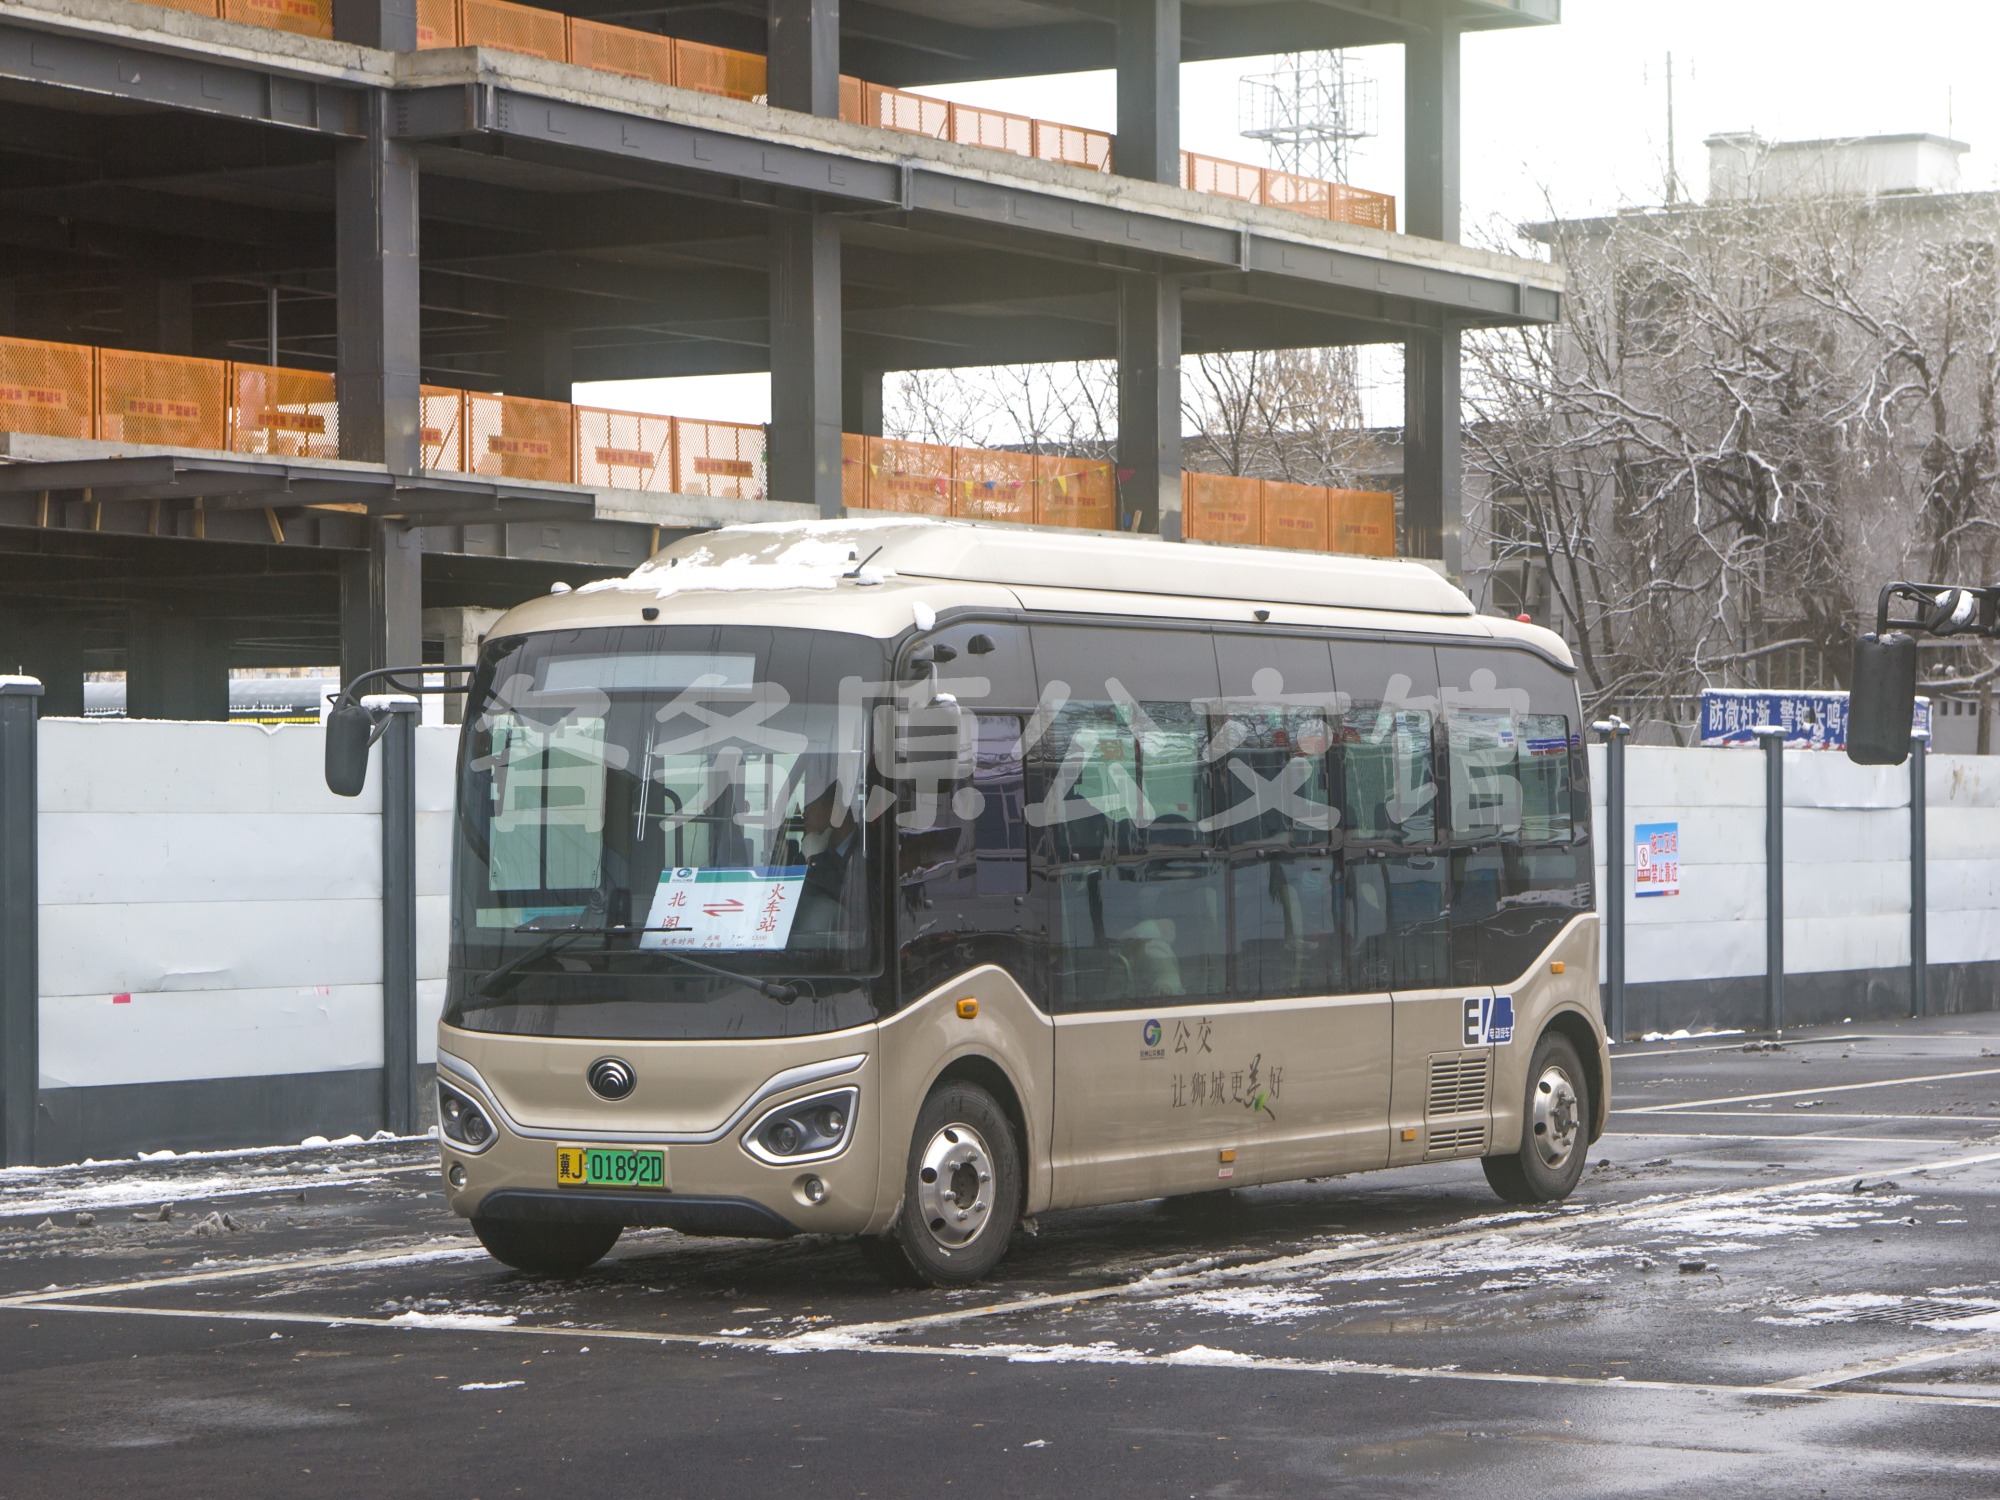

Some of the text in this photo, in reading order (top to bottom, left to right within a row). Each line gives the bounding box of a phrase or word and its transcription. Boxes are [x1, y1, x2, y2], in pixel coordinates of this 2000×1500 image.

[1709, 699, 1770, 731] 防微杜渐
[1780, 700, 1841, 735] 警钟长鸣
[1651, 862, 1678, 884] 禁止靠近
[661, 891, 687, 929] 北阁
[756, 883, 786, 932] 火车站
[1173, 1017, 1213, 1055] 公交
[1171, 1053, 1284, 1121] 让狮城更美好
[560, 1153, 661, 1182] 冀J01892D
